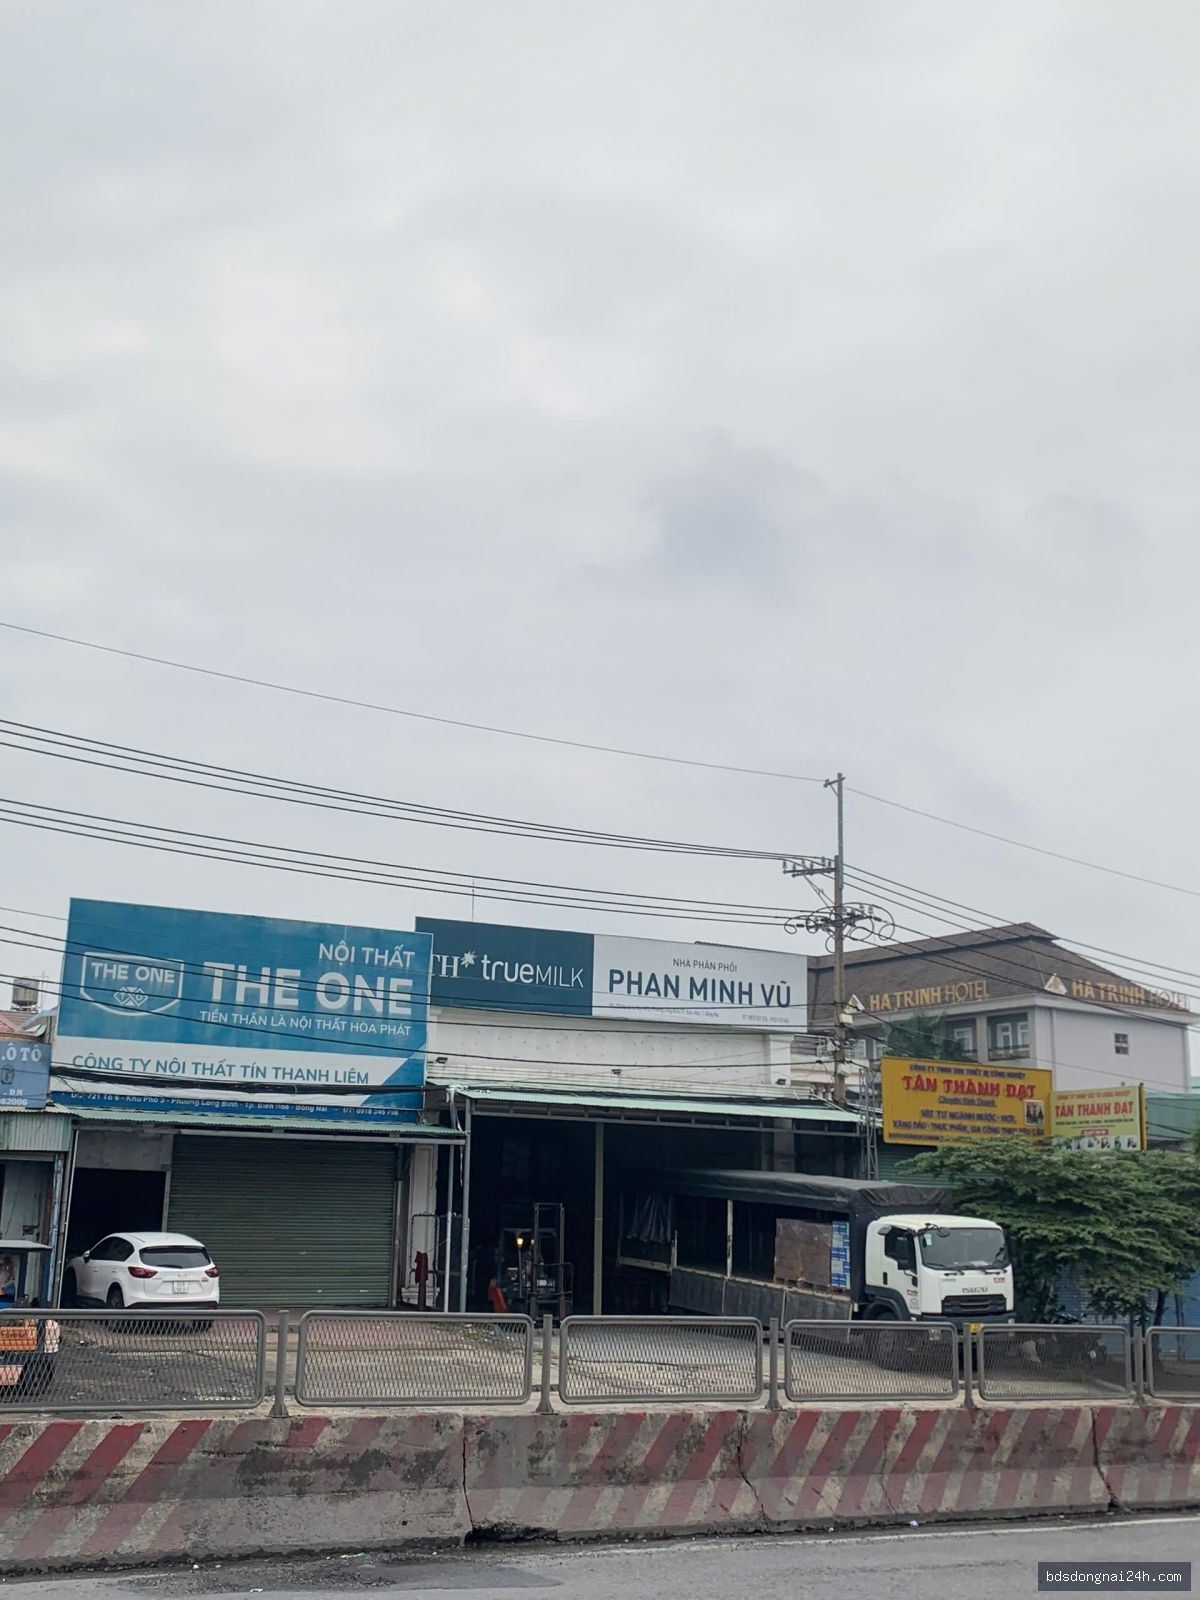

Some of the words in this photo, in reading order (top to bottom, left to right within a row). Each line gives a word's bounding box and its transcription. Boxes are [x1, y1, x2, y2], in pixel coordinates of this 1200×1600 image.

[318, 940, 356, 966] NỘI
[361, 943, 416, 969] THẤT
[673, 958, 692, 968] NHÀ
[91, 962, 129, 980] THE
[135, 966, 175, 984] ONE
[203, 961, 302, 1006] THE
[316, 971, 414, 1016] ONE
[608, 968, 680, 999] PHAN
[689, 976, 753, 1006] MINH
[760, 980, 791, 1008] VŨ
[231, 1012, 267, 1026] THÂN
[270, 1014, 287, 1027] LÀ
[289, 1015, 312, 1031] NỘI
[315, 1017, 347, 1032] THẤT
[350, 1020, 377, 1034] HÒA
[380, 1022, 412, 1036] PHÁT
[20, 1044, 42, 1062] TÔ
[72, 1052, 123, 1071] CÔNG
[129, 1057, 152, 1073] TY
[155, 1057, 186, 1077] NỘI
[191, 1058, 236, 1077] THẤT
[240, 1061, 267, 1079] TÍN
[271, 1065, 329, 1082] THANH
[334, 1068, 369, 1085] LIÊM
[902, 1074, 938, 1093] TÂN
[1005, 1082, 1037, 1101] ĐẠT
